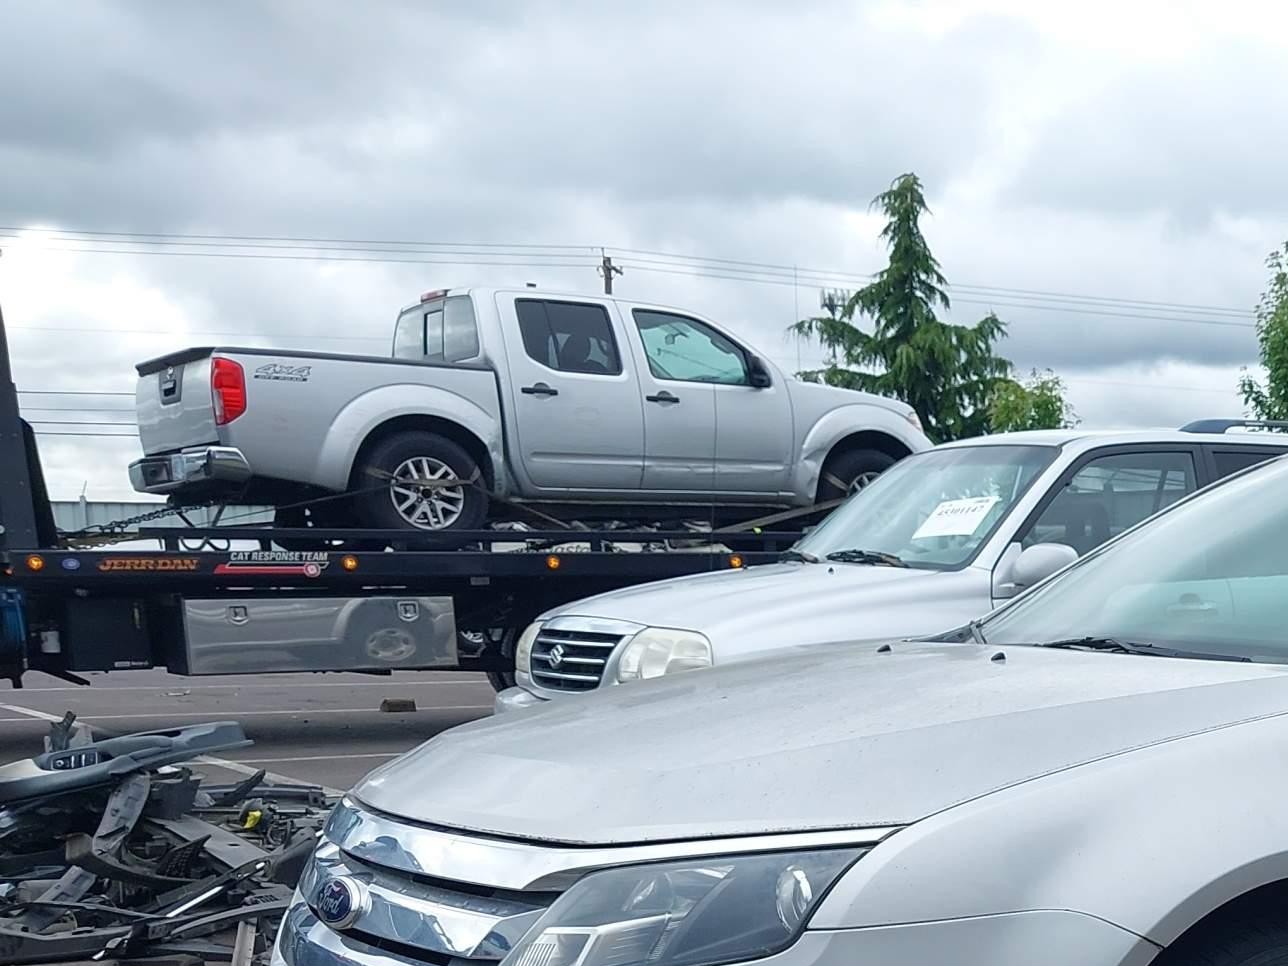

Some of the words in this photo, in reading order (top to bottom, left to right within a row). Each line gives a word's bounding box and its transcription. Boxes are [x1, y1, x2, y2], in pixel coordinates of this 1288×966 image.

[230, 551, 249, 561] CAT
[251, 551, 299, 561] RESPONSE
[301, 551, 328, 561] TEAM
[320, 883, 344, 914] Ford
